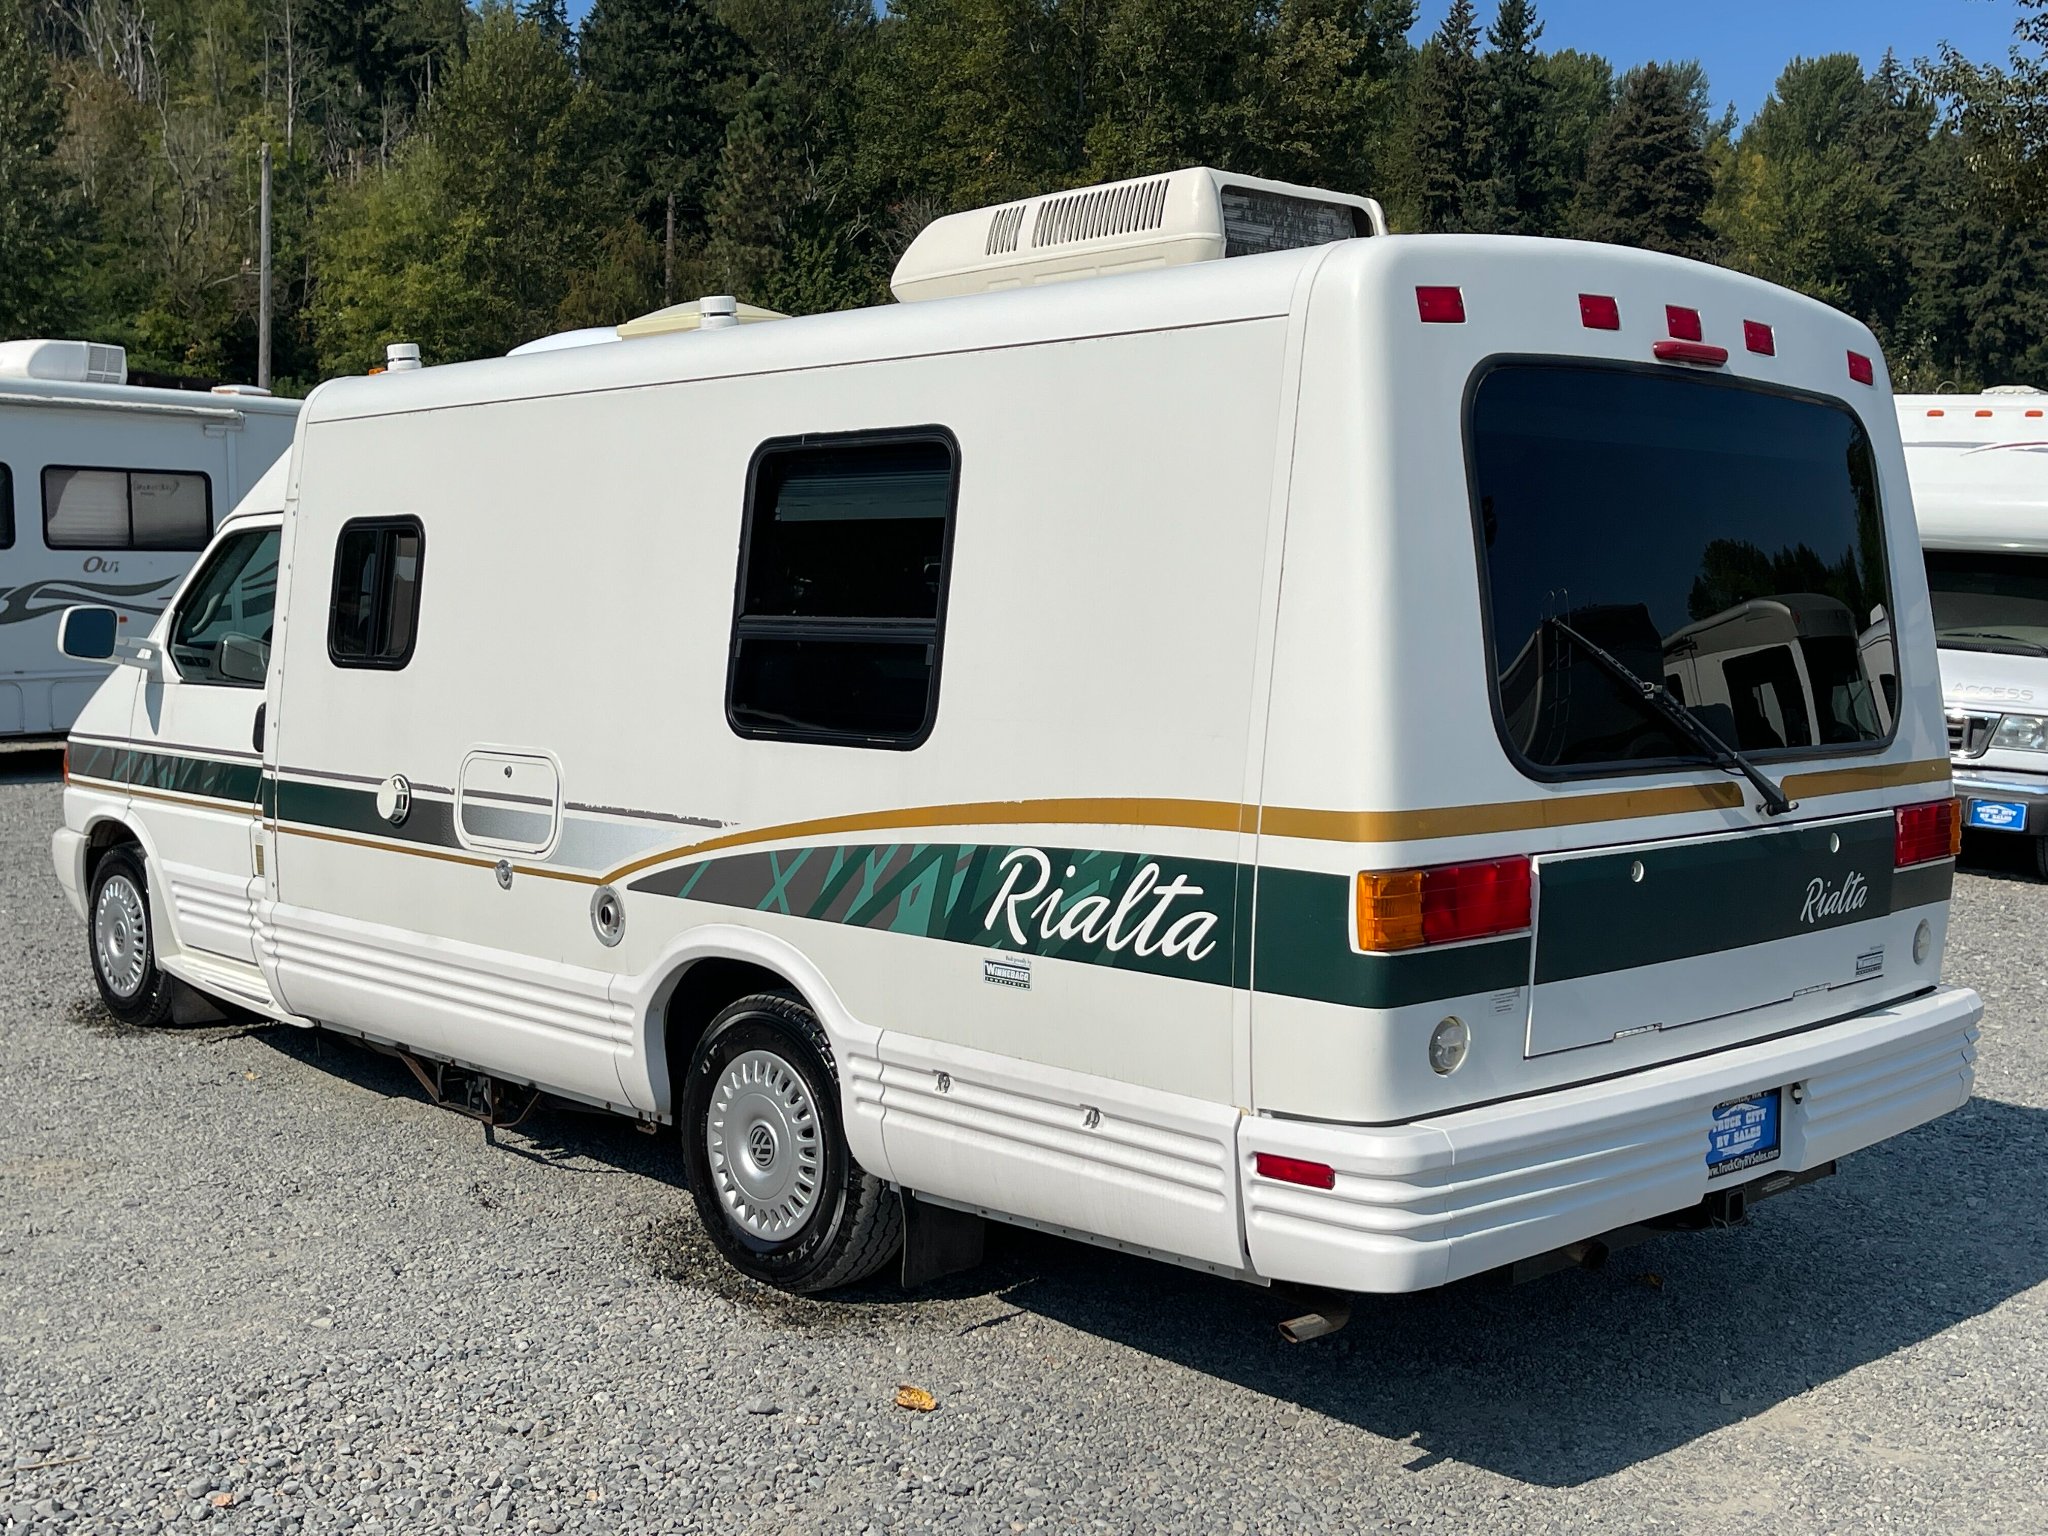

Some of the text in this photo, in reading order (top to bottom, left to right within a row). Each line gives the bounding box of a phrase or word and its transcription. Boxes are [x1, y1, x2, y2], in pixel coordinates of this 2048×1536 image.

[1952, 682, 2034, 701] ACCESS
[984, 847, 1219, 962] Rialta
[1800, 870, 1868, 923] Rialta
[985, 962, 1030, 982] WINNEBAGO
[1746, 1107, 1767, 1125] CITY
[1734, 1125, 1761, 1144] SALES
